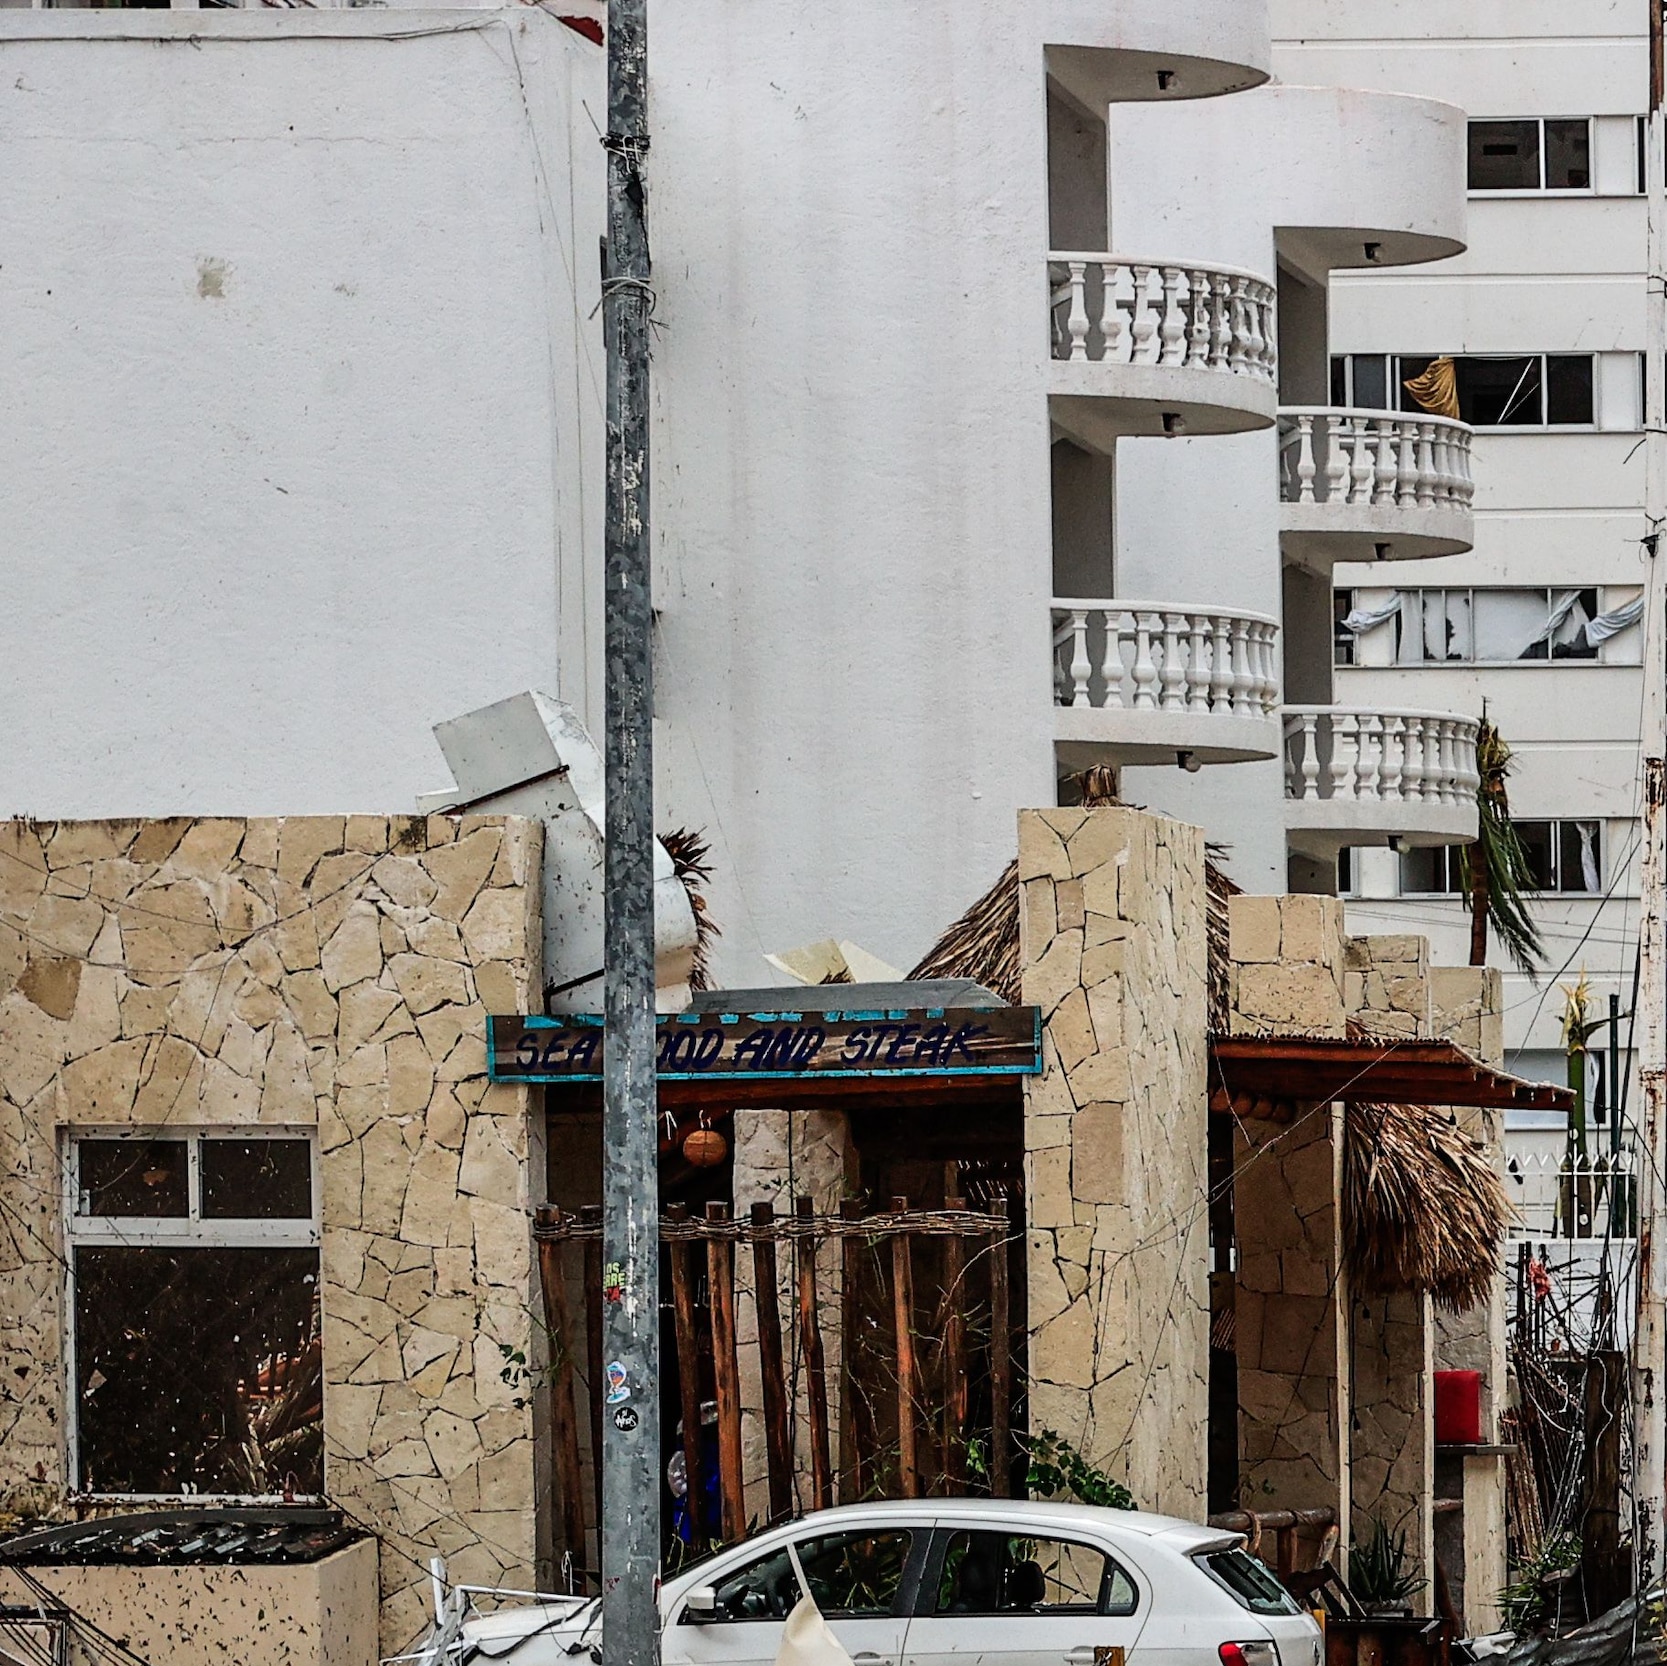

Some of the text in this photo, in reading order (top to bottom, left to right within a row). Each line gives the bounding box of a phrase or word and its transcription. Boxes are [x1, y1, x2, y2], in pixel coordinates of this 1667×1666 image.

[516, 1031, 604, 1071] SEA
[731, 1026, 826, 1070] AND
[841, 1022, 989, 1067] STEAK
